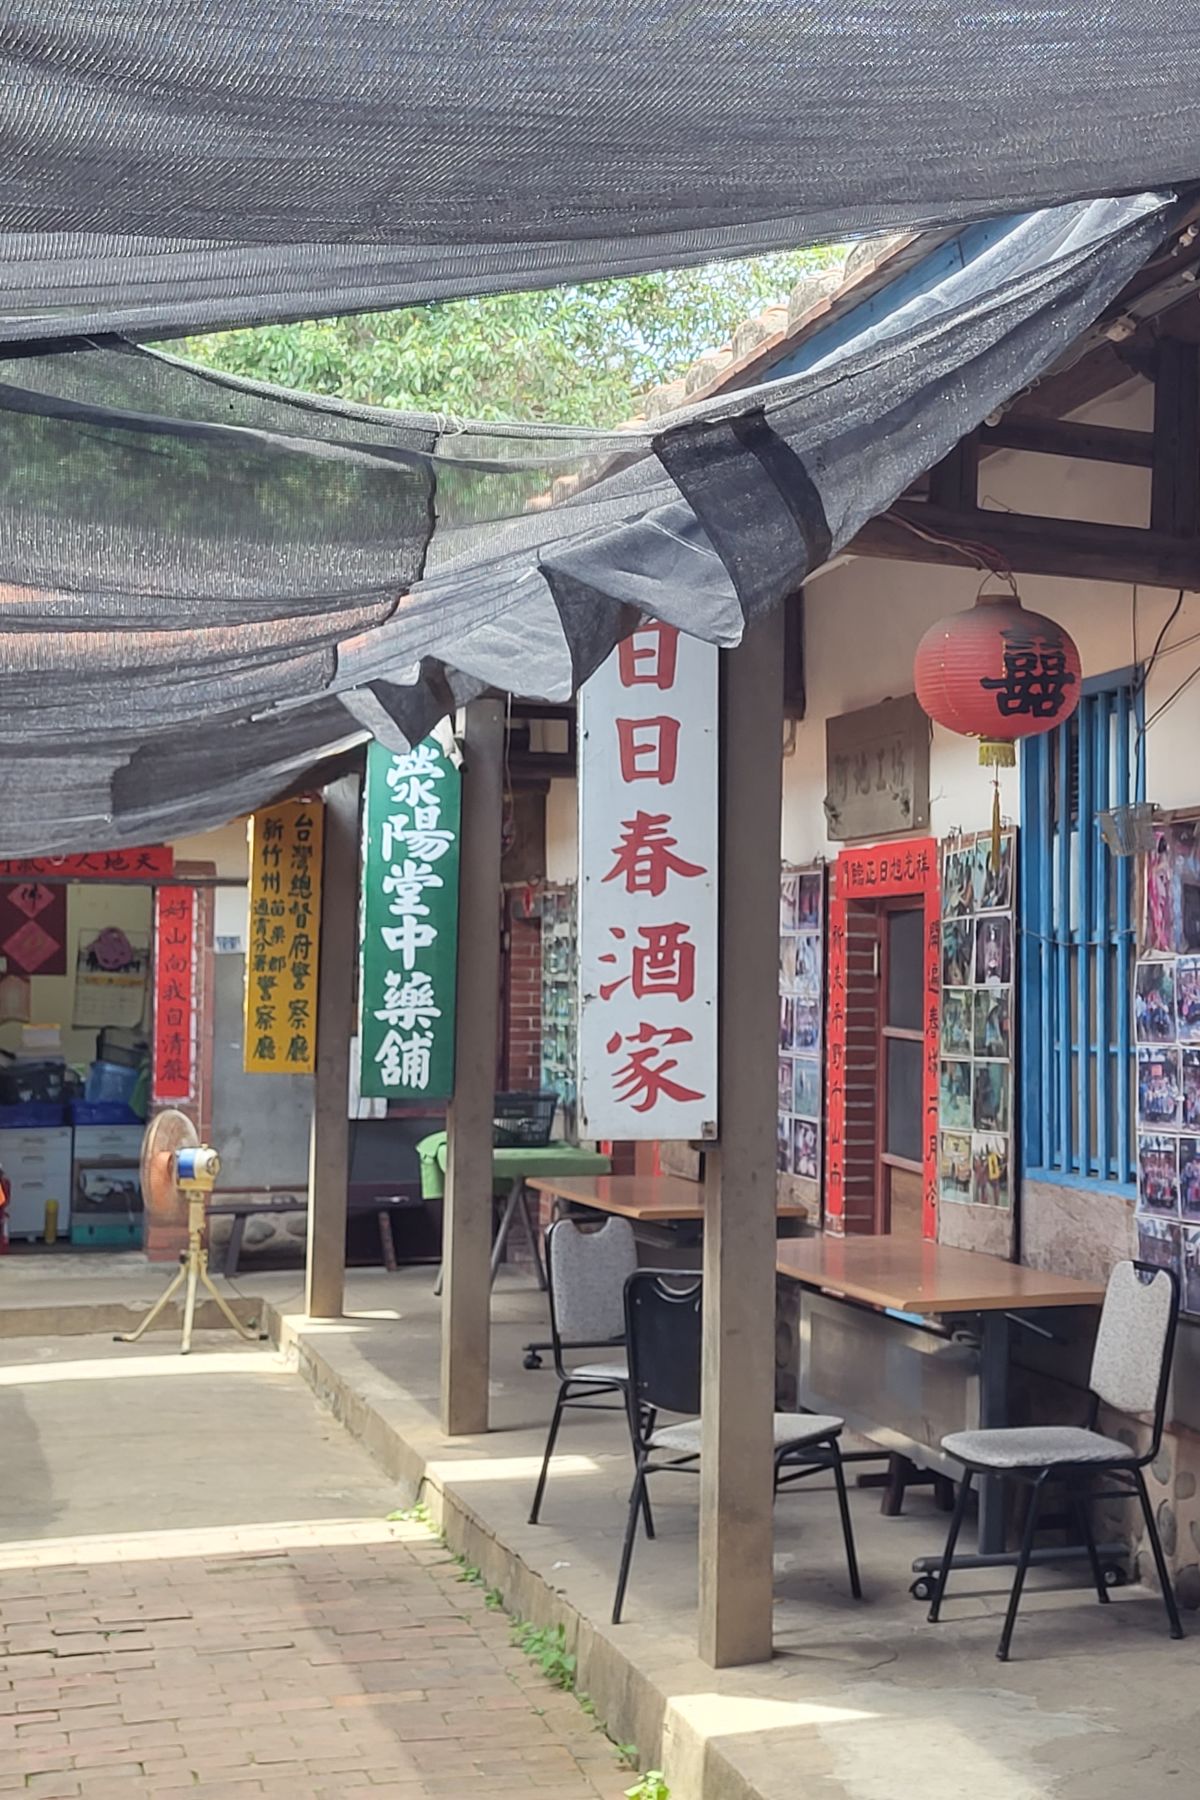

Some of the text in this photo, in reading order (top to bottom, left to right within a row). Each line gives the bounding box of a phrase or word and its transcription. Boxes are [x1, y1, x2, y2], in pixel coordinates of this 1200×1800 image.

[0, 850, 160, 874] 天地人一氣
[598, 618, 708, 1114] 日日春酒家
